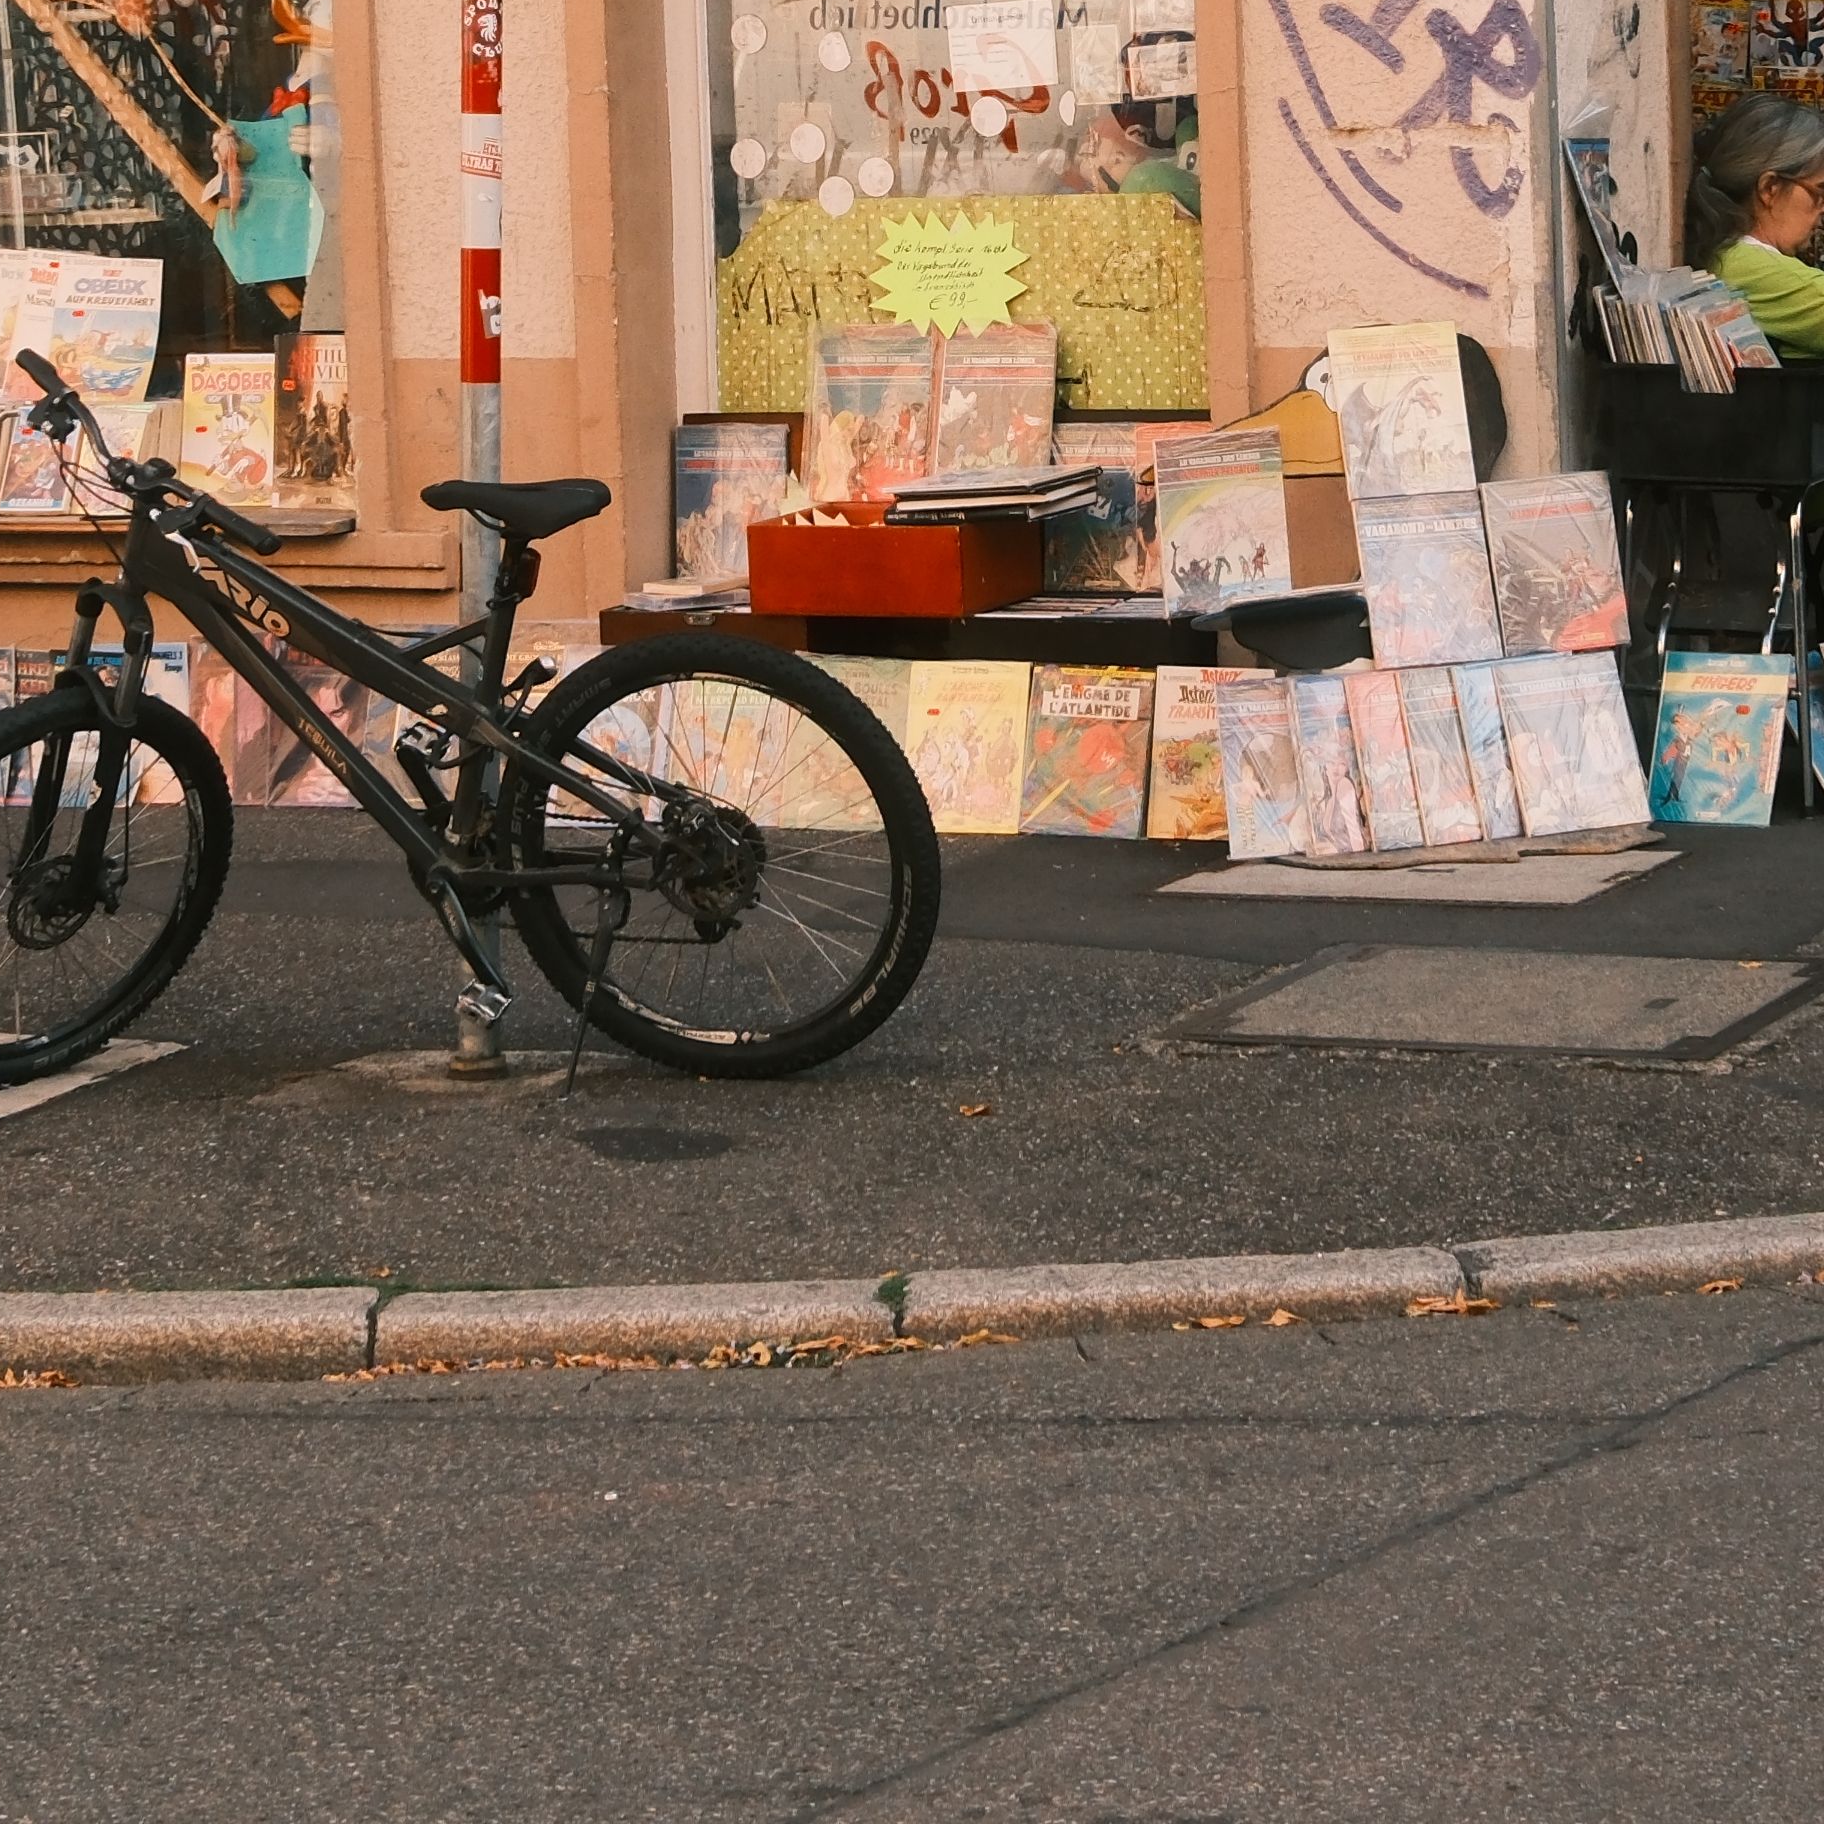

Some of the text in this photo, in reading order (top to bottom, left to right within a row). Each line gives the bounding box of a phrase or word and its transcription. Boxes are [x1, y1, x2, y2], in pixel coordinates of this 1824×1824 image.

[75, 277, 150, 296] OBELIX
[929, 293, 947, 311] €
[1691, 676, 1757, 692] FINGERS
[1114, 689, 1130, 702] DE
[1049, 703, 1131, 718] L'ATLANTIDE
